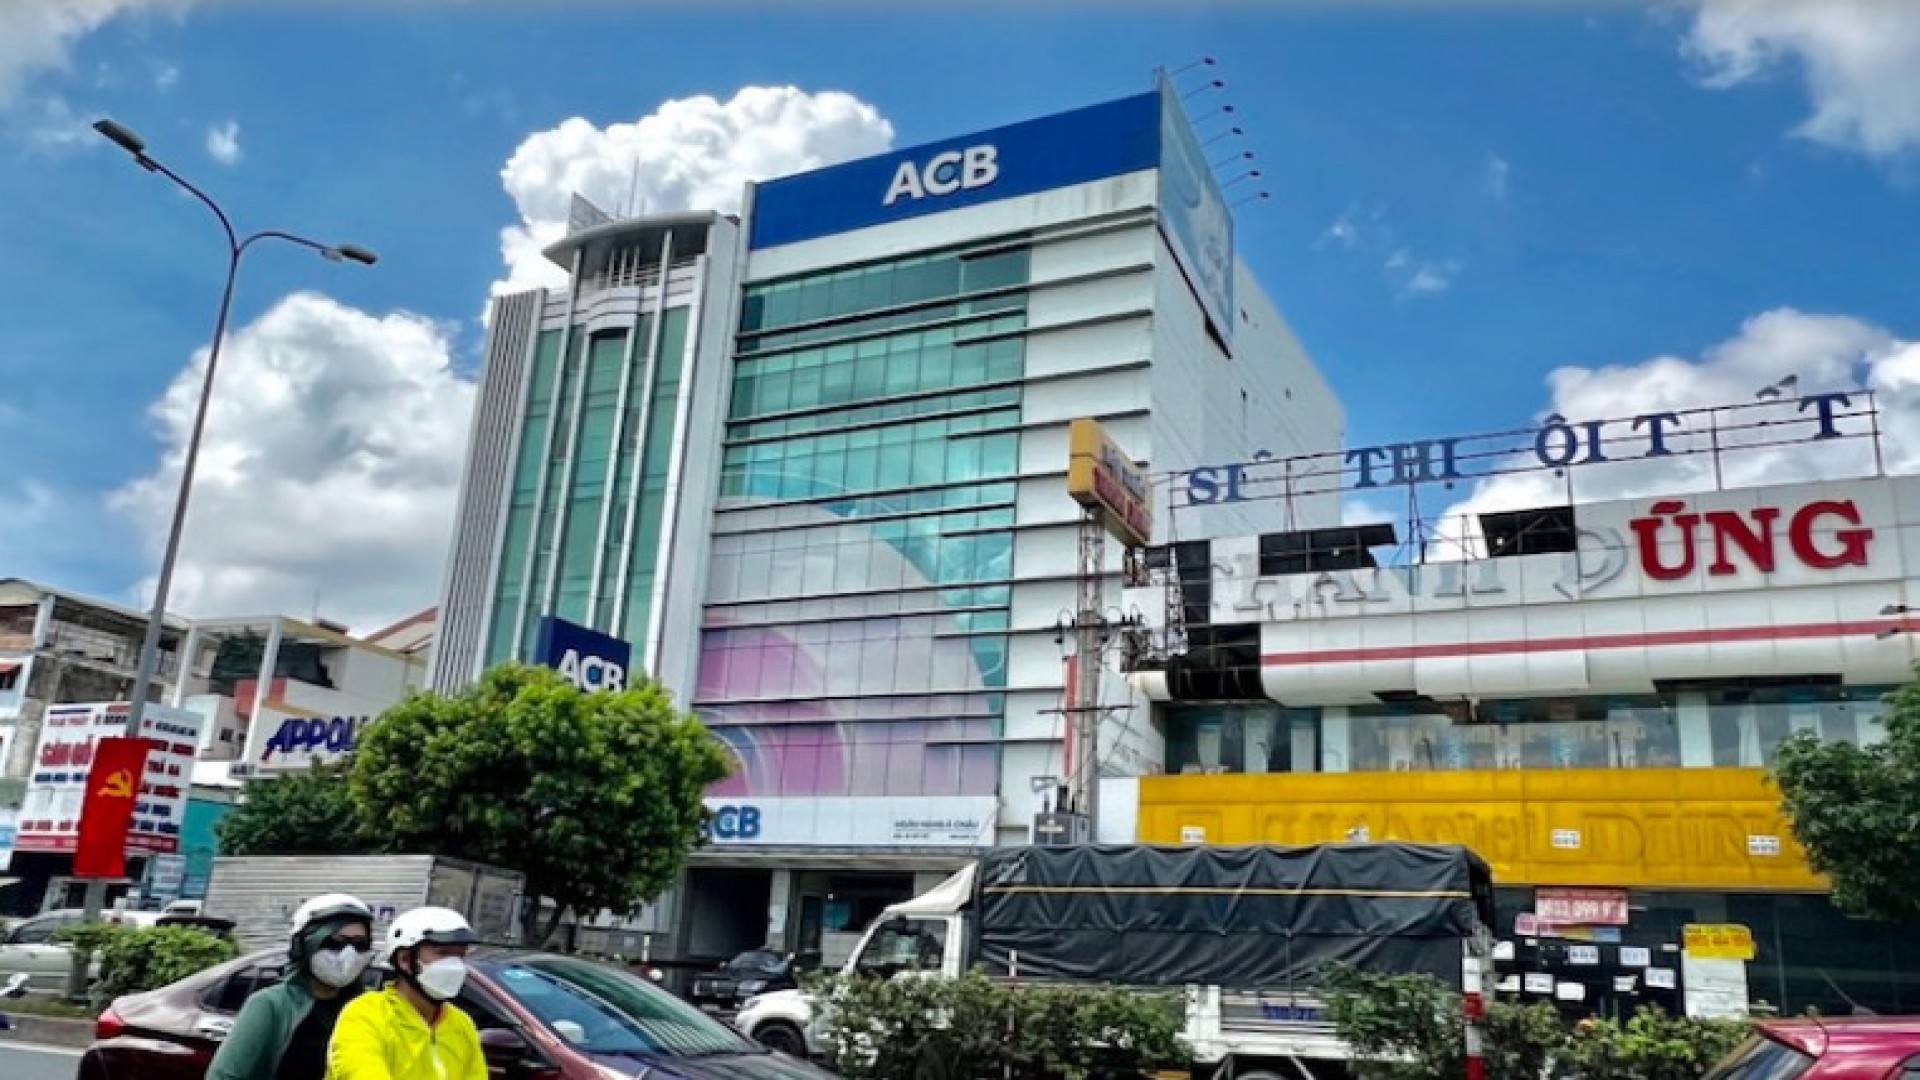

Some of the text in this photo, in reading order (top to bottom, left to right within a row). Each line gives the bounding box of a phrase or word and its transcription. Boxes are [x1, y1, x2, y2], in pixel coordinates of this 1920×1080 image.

[882, 144, 999, 206] ACB
[1344, 437, 1463, 490] THỊ
[1535, 413, 1608, 477] ỘI
[556, 648, 625, 693] ACB
[262, 716, 369, 758] APPOL
